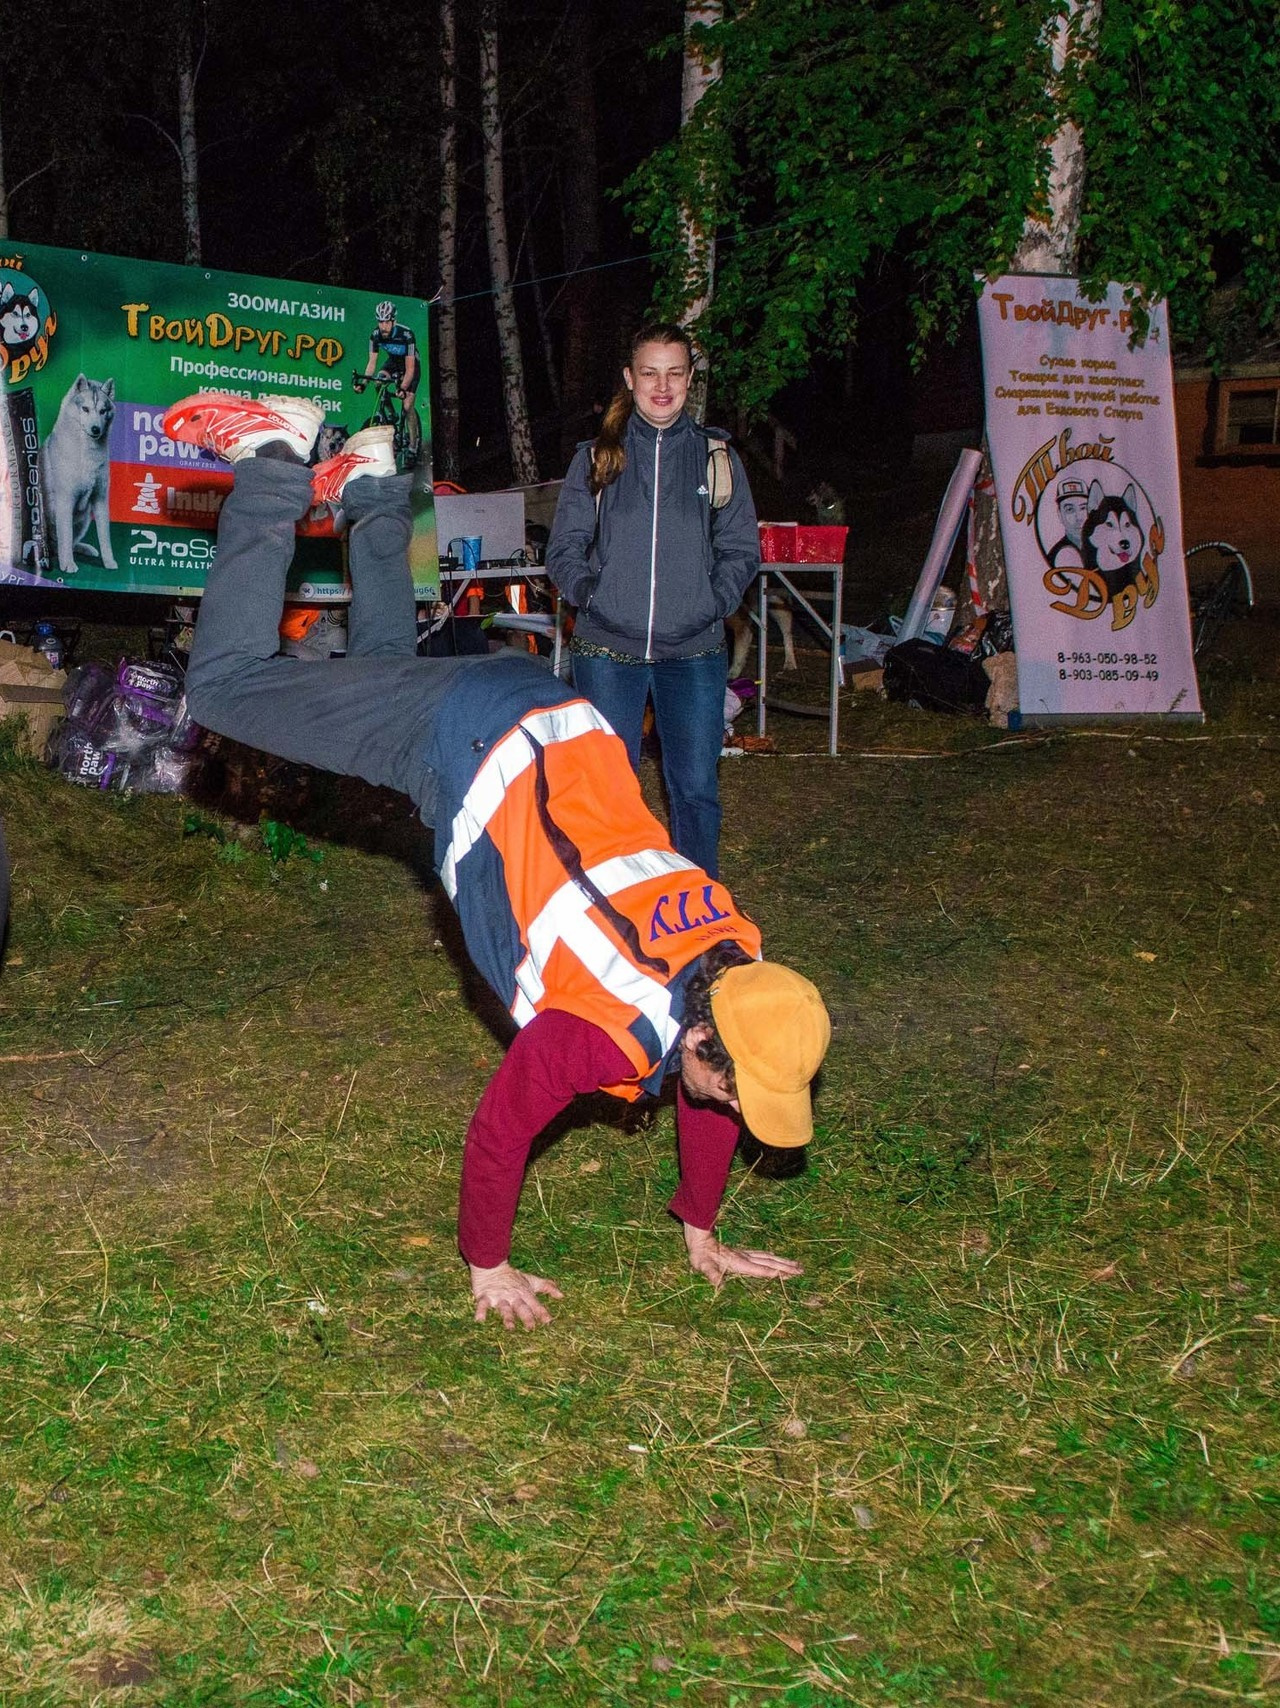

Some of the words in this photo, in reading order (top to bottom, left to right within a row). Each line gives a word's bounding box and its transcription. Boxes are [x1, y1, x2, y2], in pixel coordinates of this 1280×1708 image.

[227, 292, 345, 322] ЗООМАГАЗИН
[170, 356, 342, 390] Профессиональные
[1062, 374, 1084, 385] для
[1017, 405, 1041, 416] для
[1104, 406, 1143, 421] Спорта
[1011, 427, 1115, 527] Твой
[130, 556, 165, 568] ULTRA
[1043, 516, 1164, 631] Друг
[1057, 652, 1158, 664] 8-963-050-98-52
[1059, 669, 1159, 681] 8-903-085-09-49
[80, 742, 94, 775] north
[88, 750, 101, 776] paw
[650, 885, 731, 942] ТТУ
